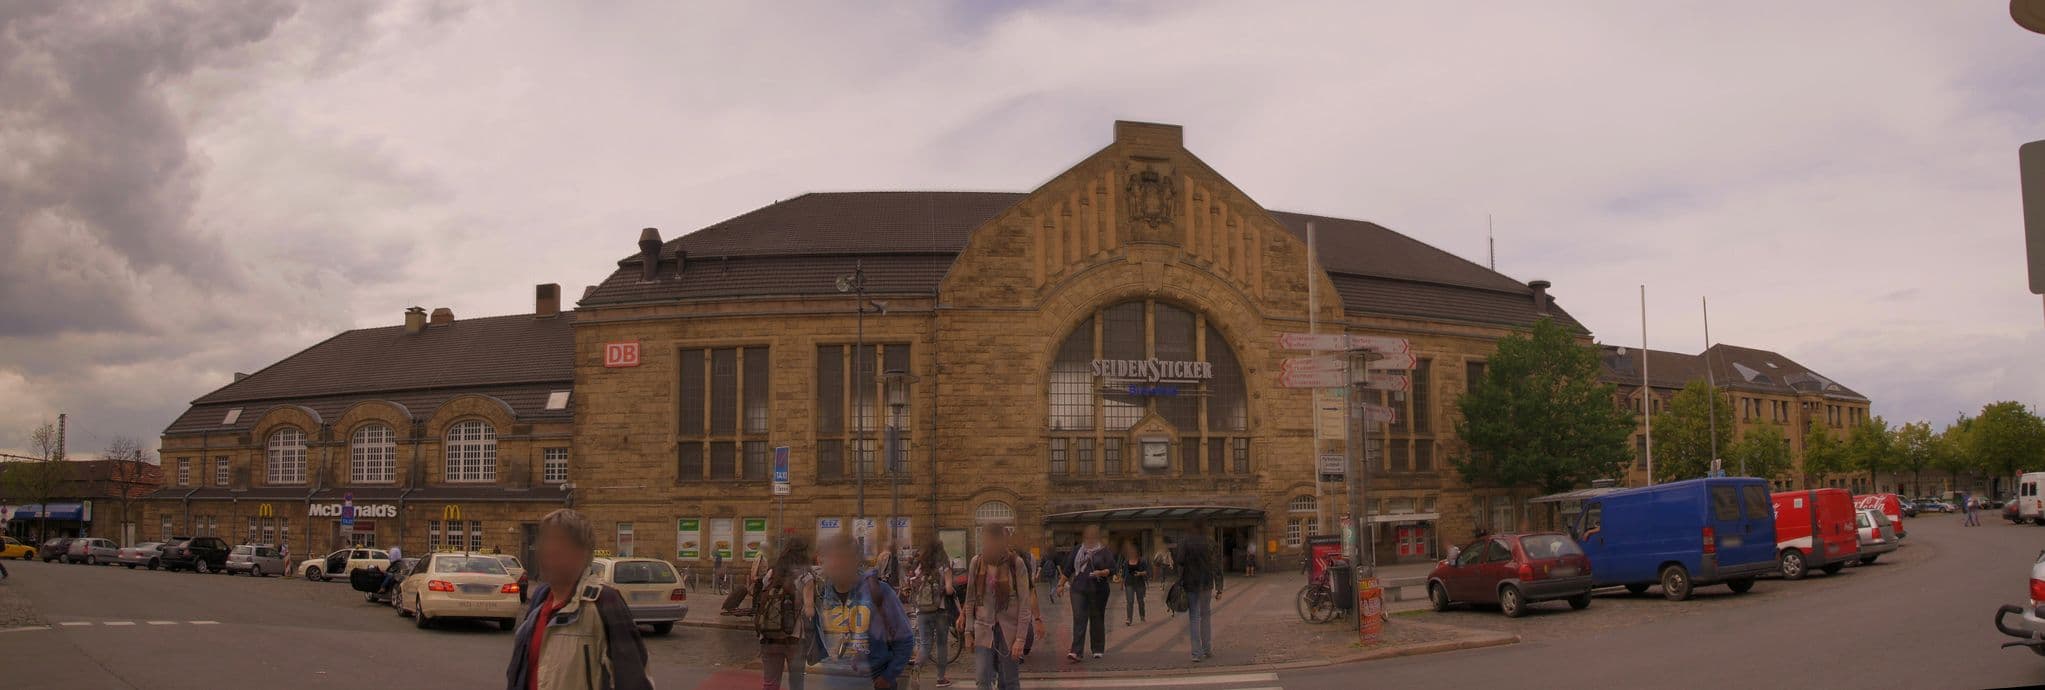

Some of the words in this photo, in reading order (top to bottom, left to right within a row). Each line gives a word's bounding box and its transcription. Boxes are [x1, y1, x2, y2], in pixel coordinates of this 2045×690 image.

[609, 346, 636, 362] DB
[1091, 357, 1213, 383] SEIDENSTICKER
[308, 503, 397, 518] McDnald's
[823, 605, 871, 633] 20
